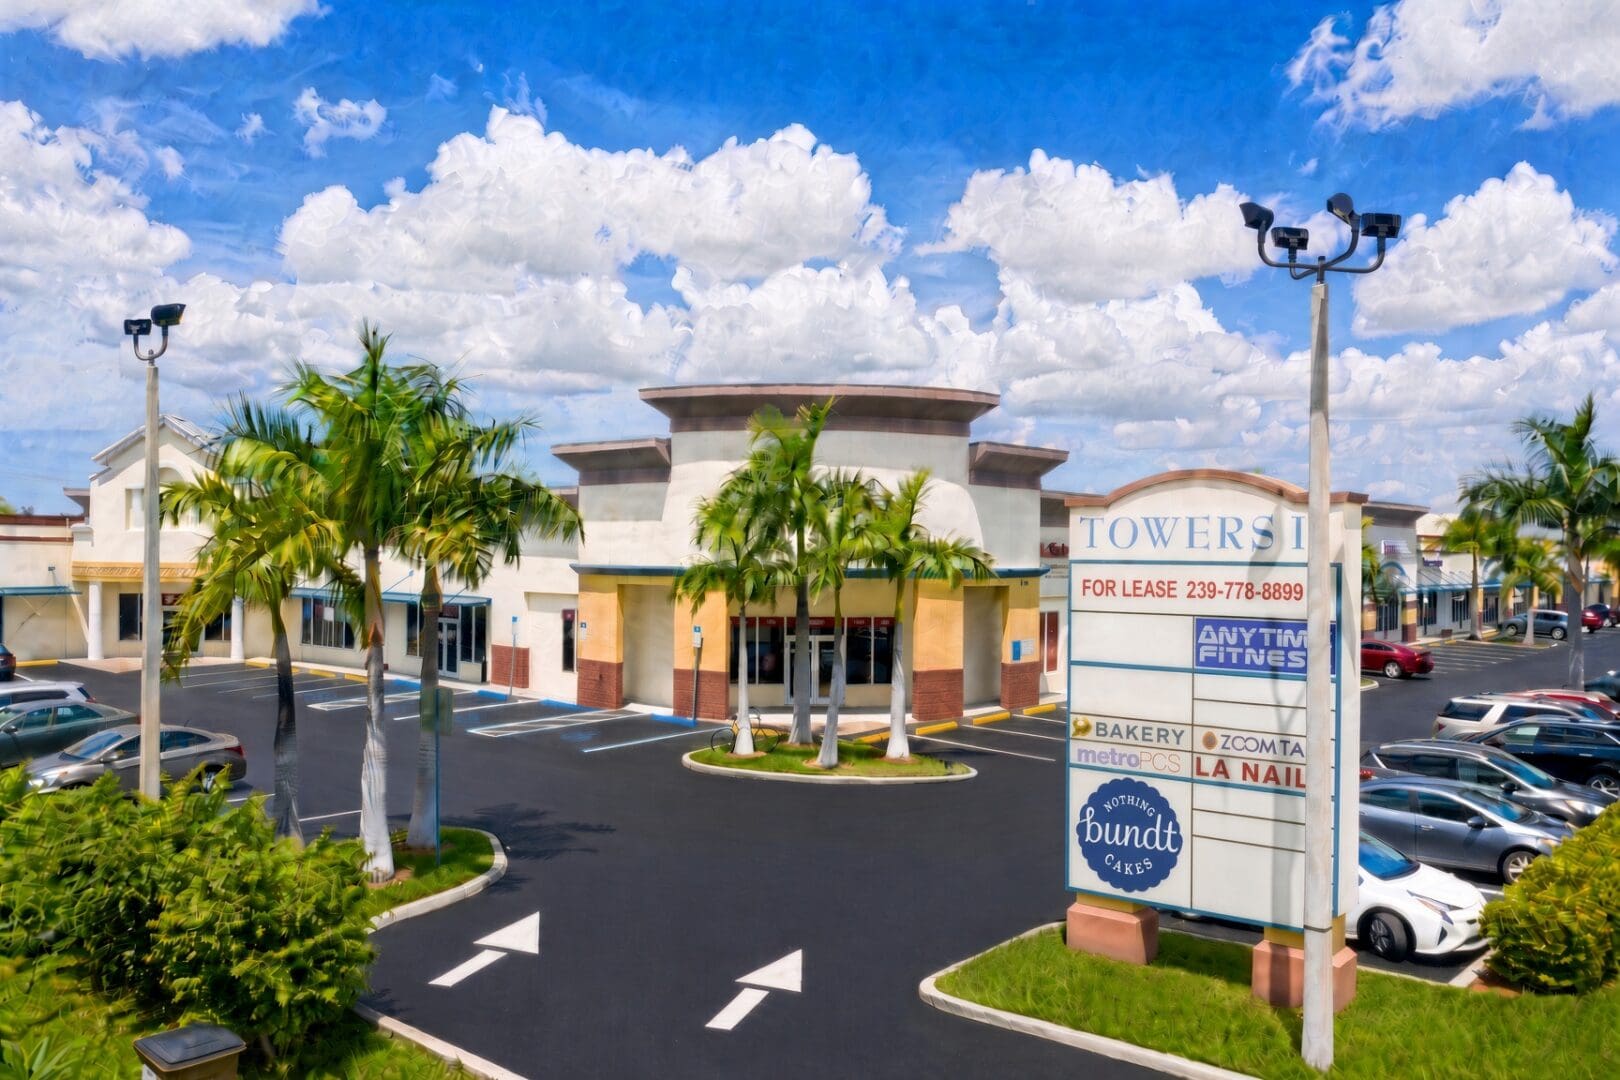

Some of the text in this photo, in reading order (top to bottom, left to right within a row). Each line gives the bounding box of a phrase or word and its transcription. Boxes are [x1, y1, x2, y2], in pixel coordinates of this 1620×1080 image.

[1079, 514, 1274, 551] TOWERS
[1082, 578, 1304, 602] FOR LEASE 239-778-8899
[1198, 625, 1309, 649] ANYTIM
[1199, 645, 1308, 668] FITNES
[1095, 721, 1185, 746] BAKERY
[1077, 746, 1181, 773] metroPCS
[1196, 757, 1230, 779] LA
[1103, 795, 1156, 817] NOTHING
[1080, 806, 1179, 853] bundt
[1105, 854, 1153, 875] CAKES
